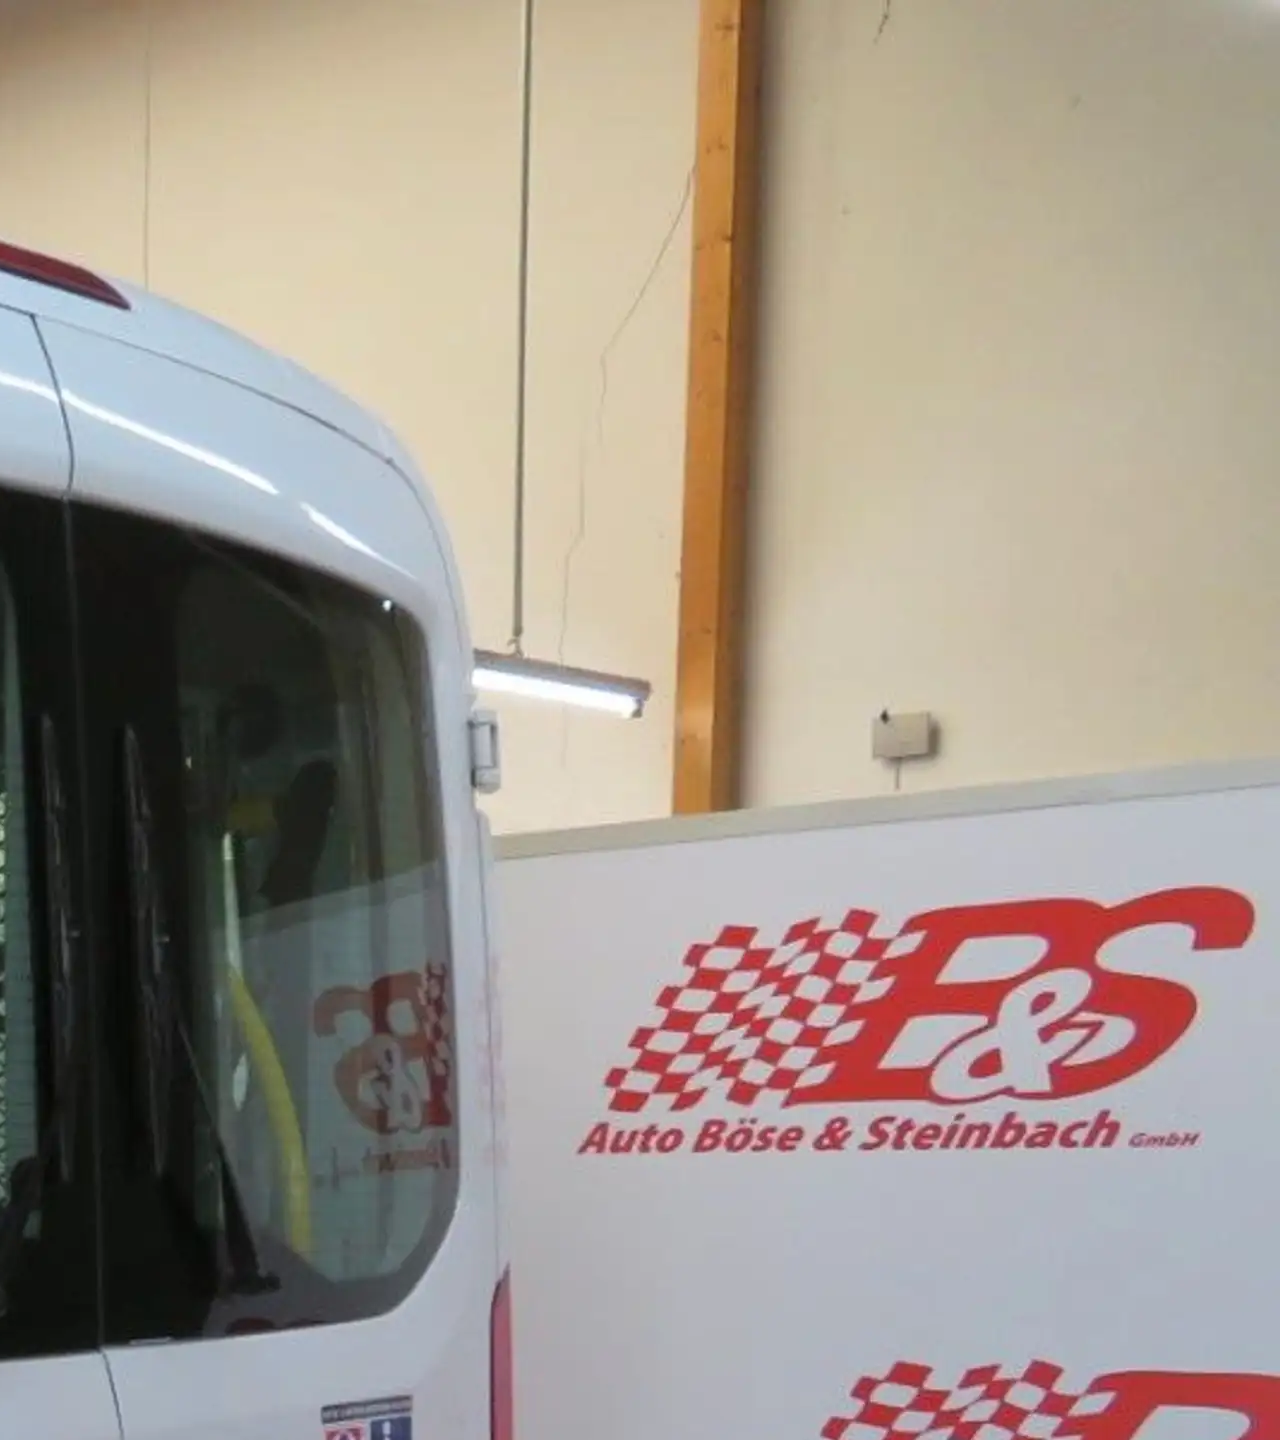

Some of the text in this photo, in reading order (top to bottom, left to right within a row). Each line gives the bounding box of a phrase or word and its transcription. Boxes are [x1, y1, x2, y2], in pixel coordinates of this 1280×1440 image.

[783, 886, 1256, 1105] B&S
[578, 1111, 1202, 1155] Auto Böse & Steinbach GmbH
